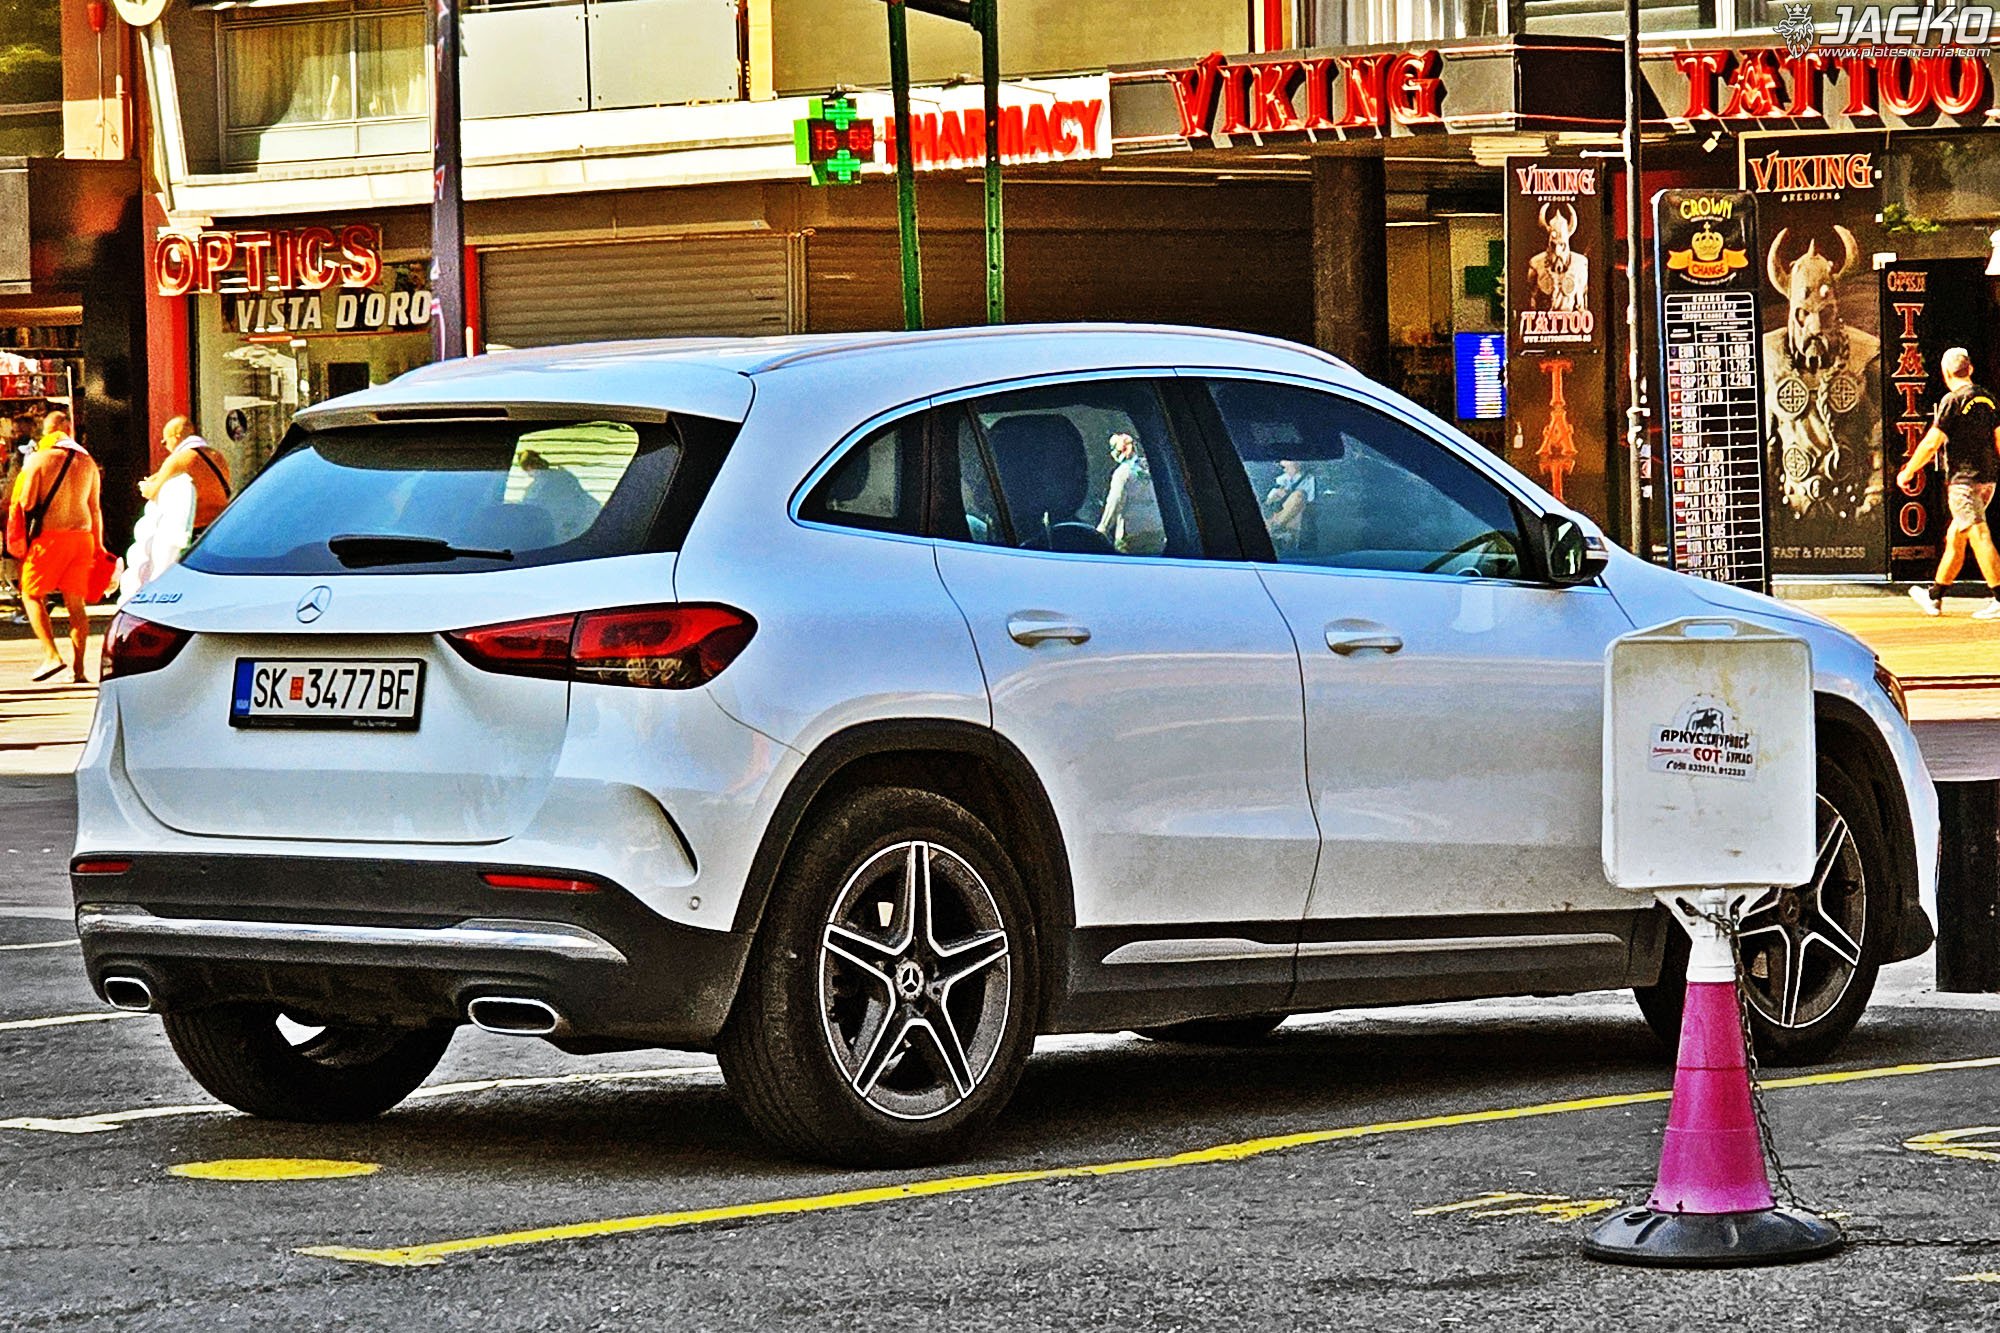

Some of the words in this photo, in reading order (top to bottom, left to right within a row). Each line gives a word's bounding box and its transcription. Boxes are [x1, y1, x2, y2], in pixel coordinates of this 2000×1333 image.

[1165, 49, 1447, 136] VIKING
[1672, 45, 1985, 118] TATTOO
[885, 99, 1103, 165] PHARMACY
[1516, 164, 1595, 195] VIKING
[1748, 149, 1874, 193] VIKING
[1680, 197, 1732, 219] CROWN
[154, 224, 383, 296] OPTICS
[1692, 263, 1725, 275] CHANGE
[237, 296, 323, 333] VISTA
[336, 290, 432, 330] D'ORO
[1521, 310, 1594, 334] TATTOO
[1772, 547, 1801, 559] FAST
[1802, 547, 1812, 559] &
[1813, 546, 1866, 559] PAINLESS
[253, 668, 287, 709] SK
